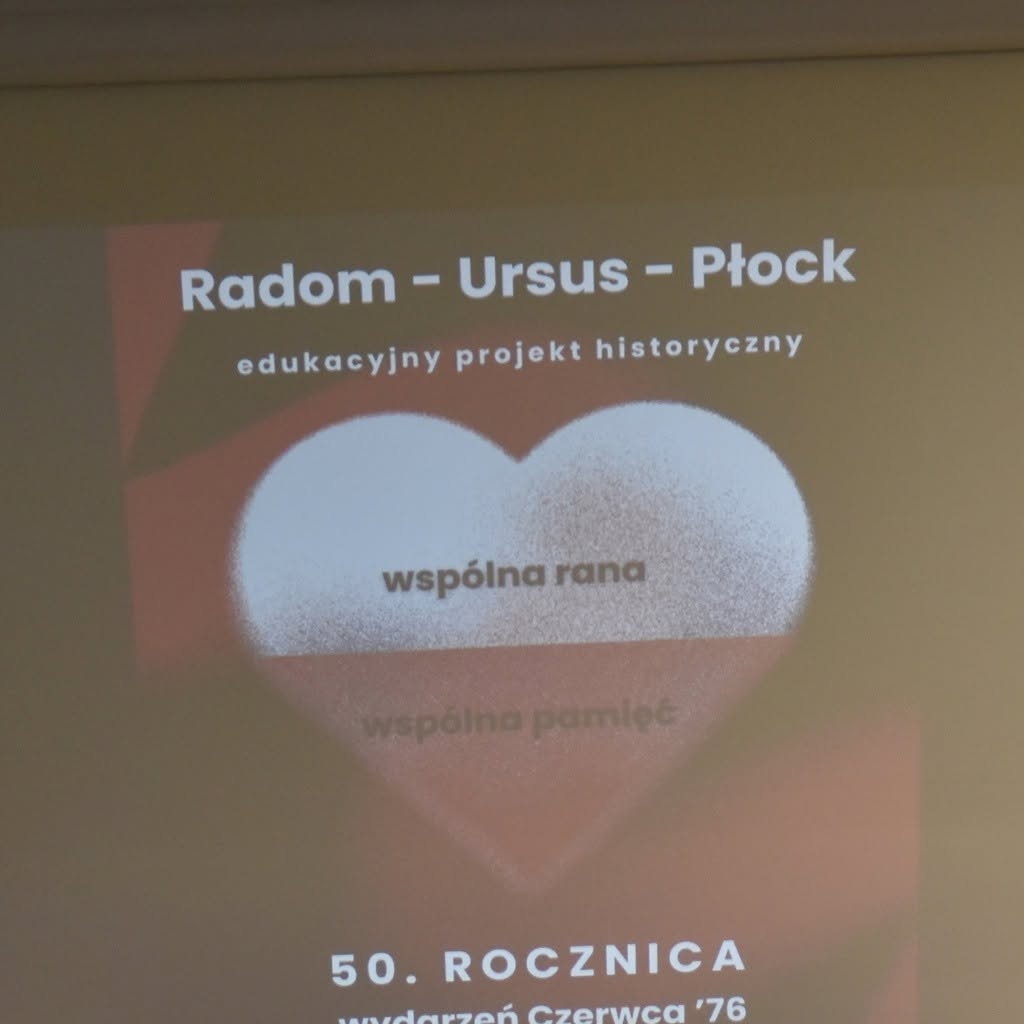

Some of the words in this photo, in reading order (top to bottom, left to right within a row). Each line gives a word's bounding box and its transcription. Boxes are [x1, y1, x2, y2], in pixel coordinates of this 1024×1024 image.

[180, 263, 396, 312] Radom
[458, 253, 630, 299] Ursus
[692, 237, 857, 289] Płock
[236, 343, 441, 377] edukacyjny
[456, 337, 583, 371] projekt
[597, 330, 804, 363] historyczny
[382, 559, 546, 599] wspólna
[555, 560, 647, 586] rana
[362, 704, 522, 745] wspólna
[532, 698, 678, 740] pamięć
[331, 952, 418, 987] 50.
[444, 939, 746, 983] ROCZNICA
